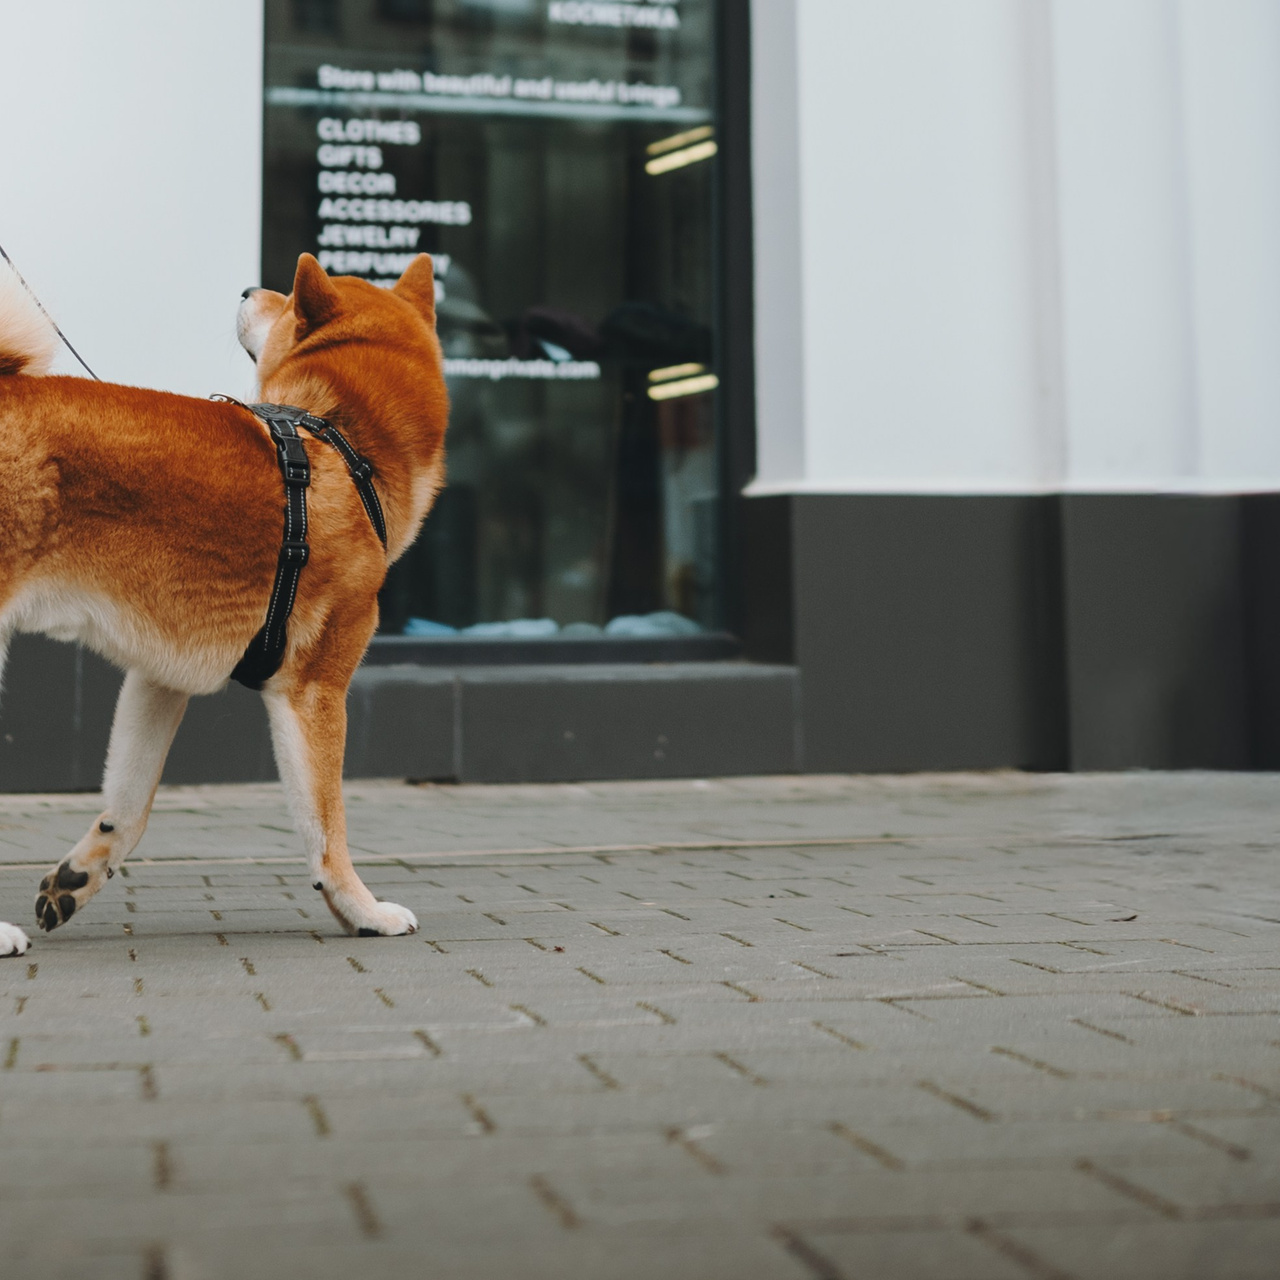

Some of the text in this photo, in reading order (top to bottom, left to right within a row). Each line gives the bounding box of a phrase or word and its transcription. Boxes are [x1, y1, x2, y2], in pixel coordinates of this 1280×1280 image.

[318, 63, 375, 91] Store
[376, 67, 421, 93] with
[422, 70, 513, 98] beautiful
[513, 75, 554, 100] and
[317, 117, 421, 146] CLOTHES
[317, 143, 384, 170] GIFTS
[318, 170, 397, 196] DECOR
[318, 197, 473, 227] ACCESSORIES
[317, 223, 421, 249] JEWELRY
